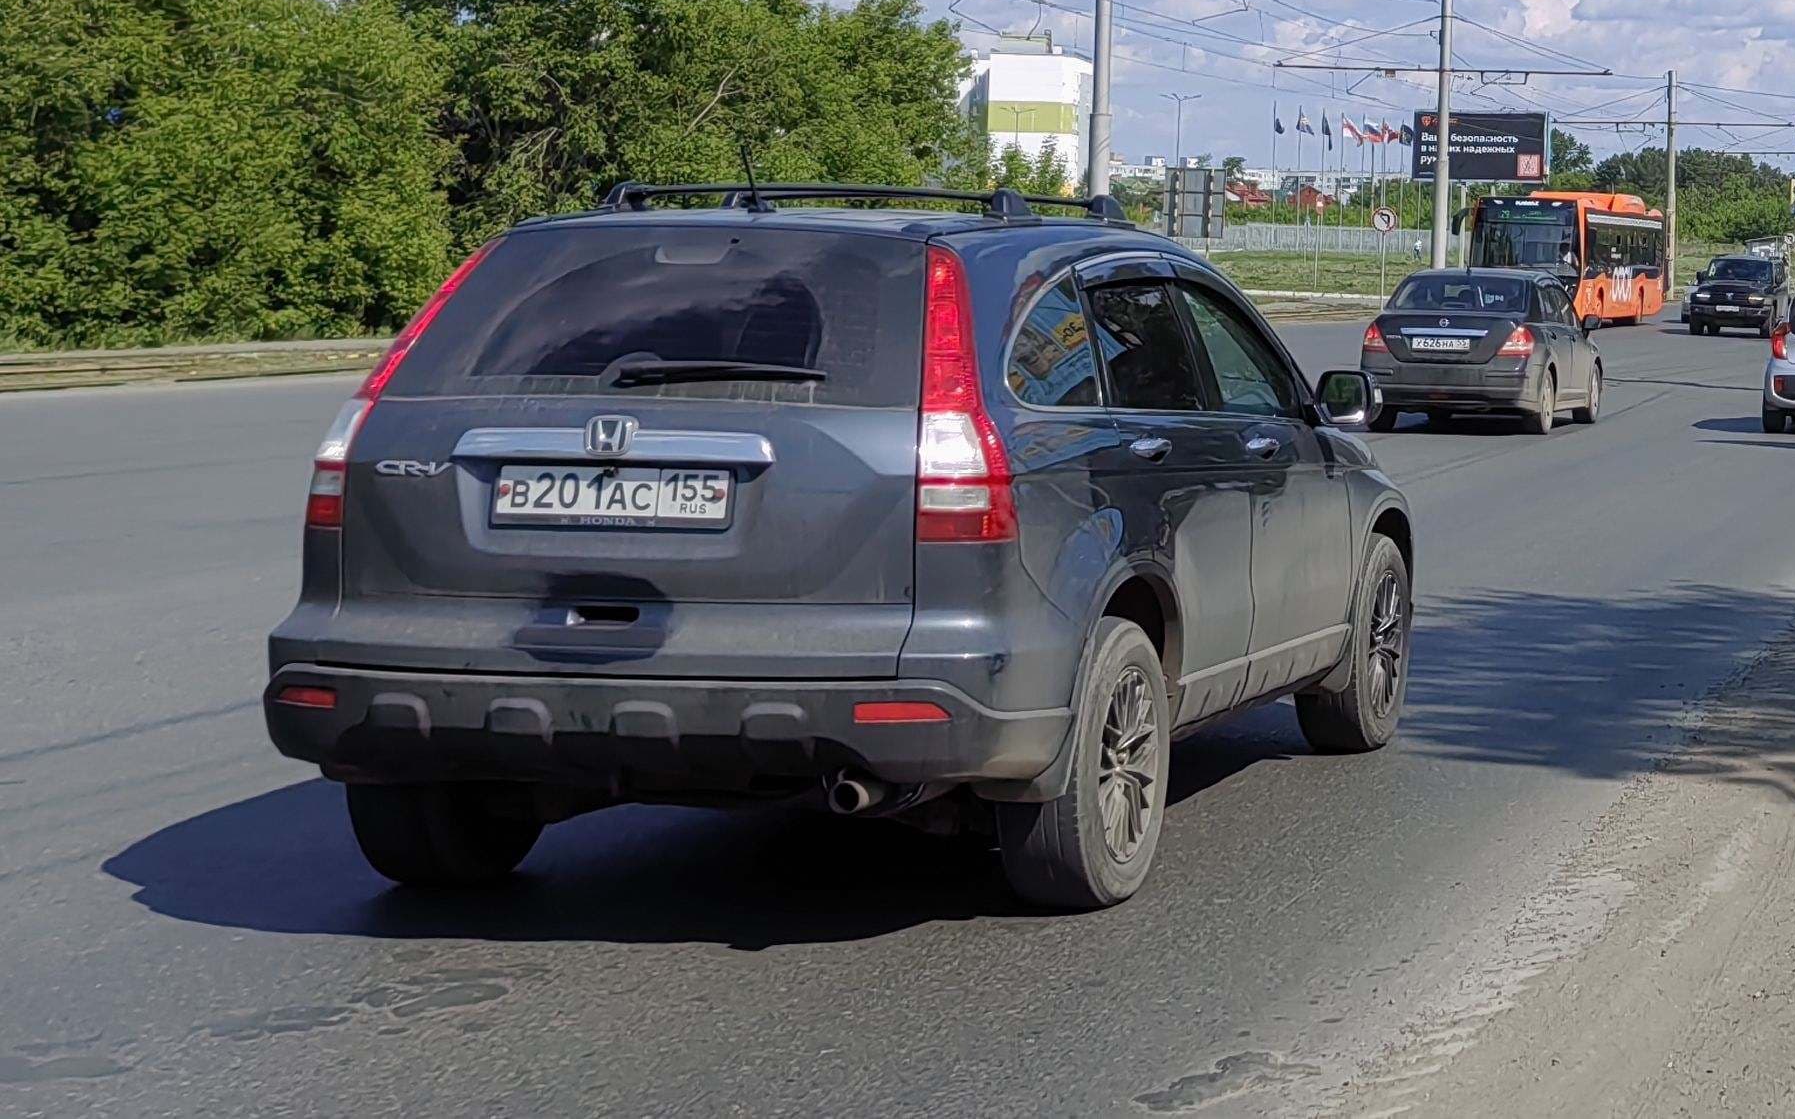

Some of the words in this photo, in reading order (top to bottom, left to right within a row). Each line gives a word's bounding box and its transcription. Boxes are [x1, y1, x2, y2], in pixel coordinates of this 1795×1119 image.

[1450, 133, 1519, 143] безопасность
[1463, 146, 1515, 154] надежных
[375, 459, 452, 479] CR-V
[664, 472, 720, 503] 155
[679, 503, 707, 515] RUS
[580, 516, 636, 526] HONDA
